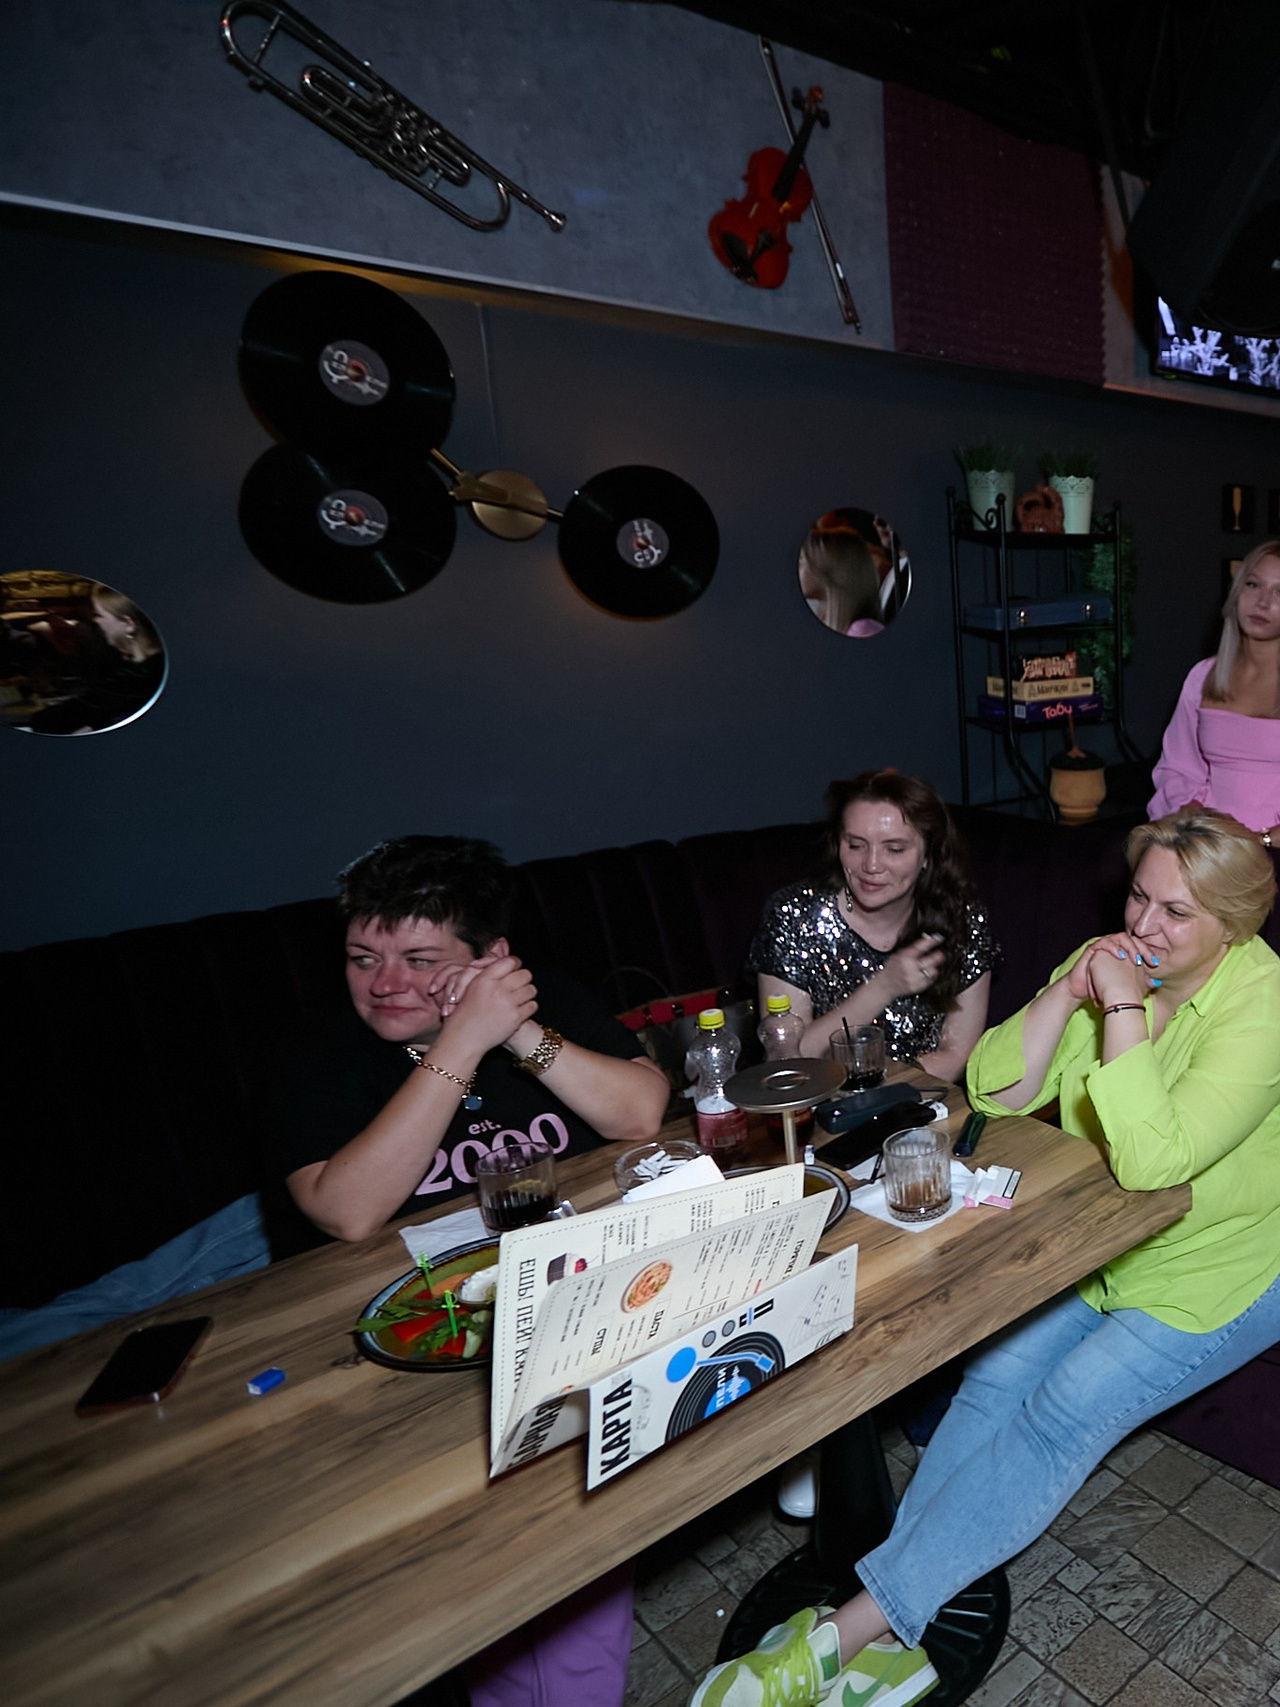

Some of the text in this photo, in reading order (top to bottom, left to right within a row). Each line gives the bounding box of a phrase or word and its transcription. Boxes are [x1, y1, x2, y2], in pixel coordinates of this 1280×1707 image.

[414, 1112, 570, 1196] 2000
[468, 1119, 502, 1135] est.
[518, 1258, 536, 1300] ЕШЬ!
[600, 1379, 633, 1476] КАРТА
